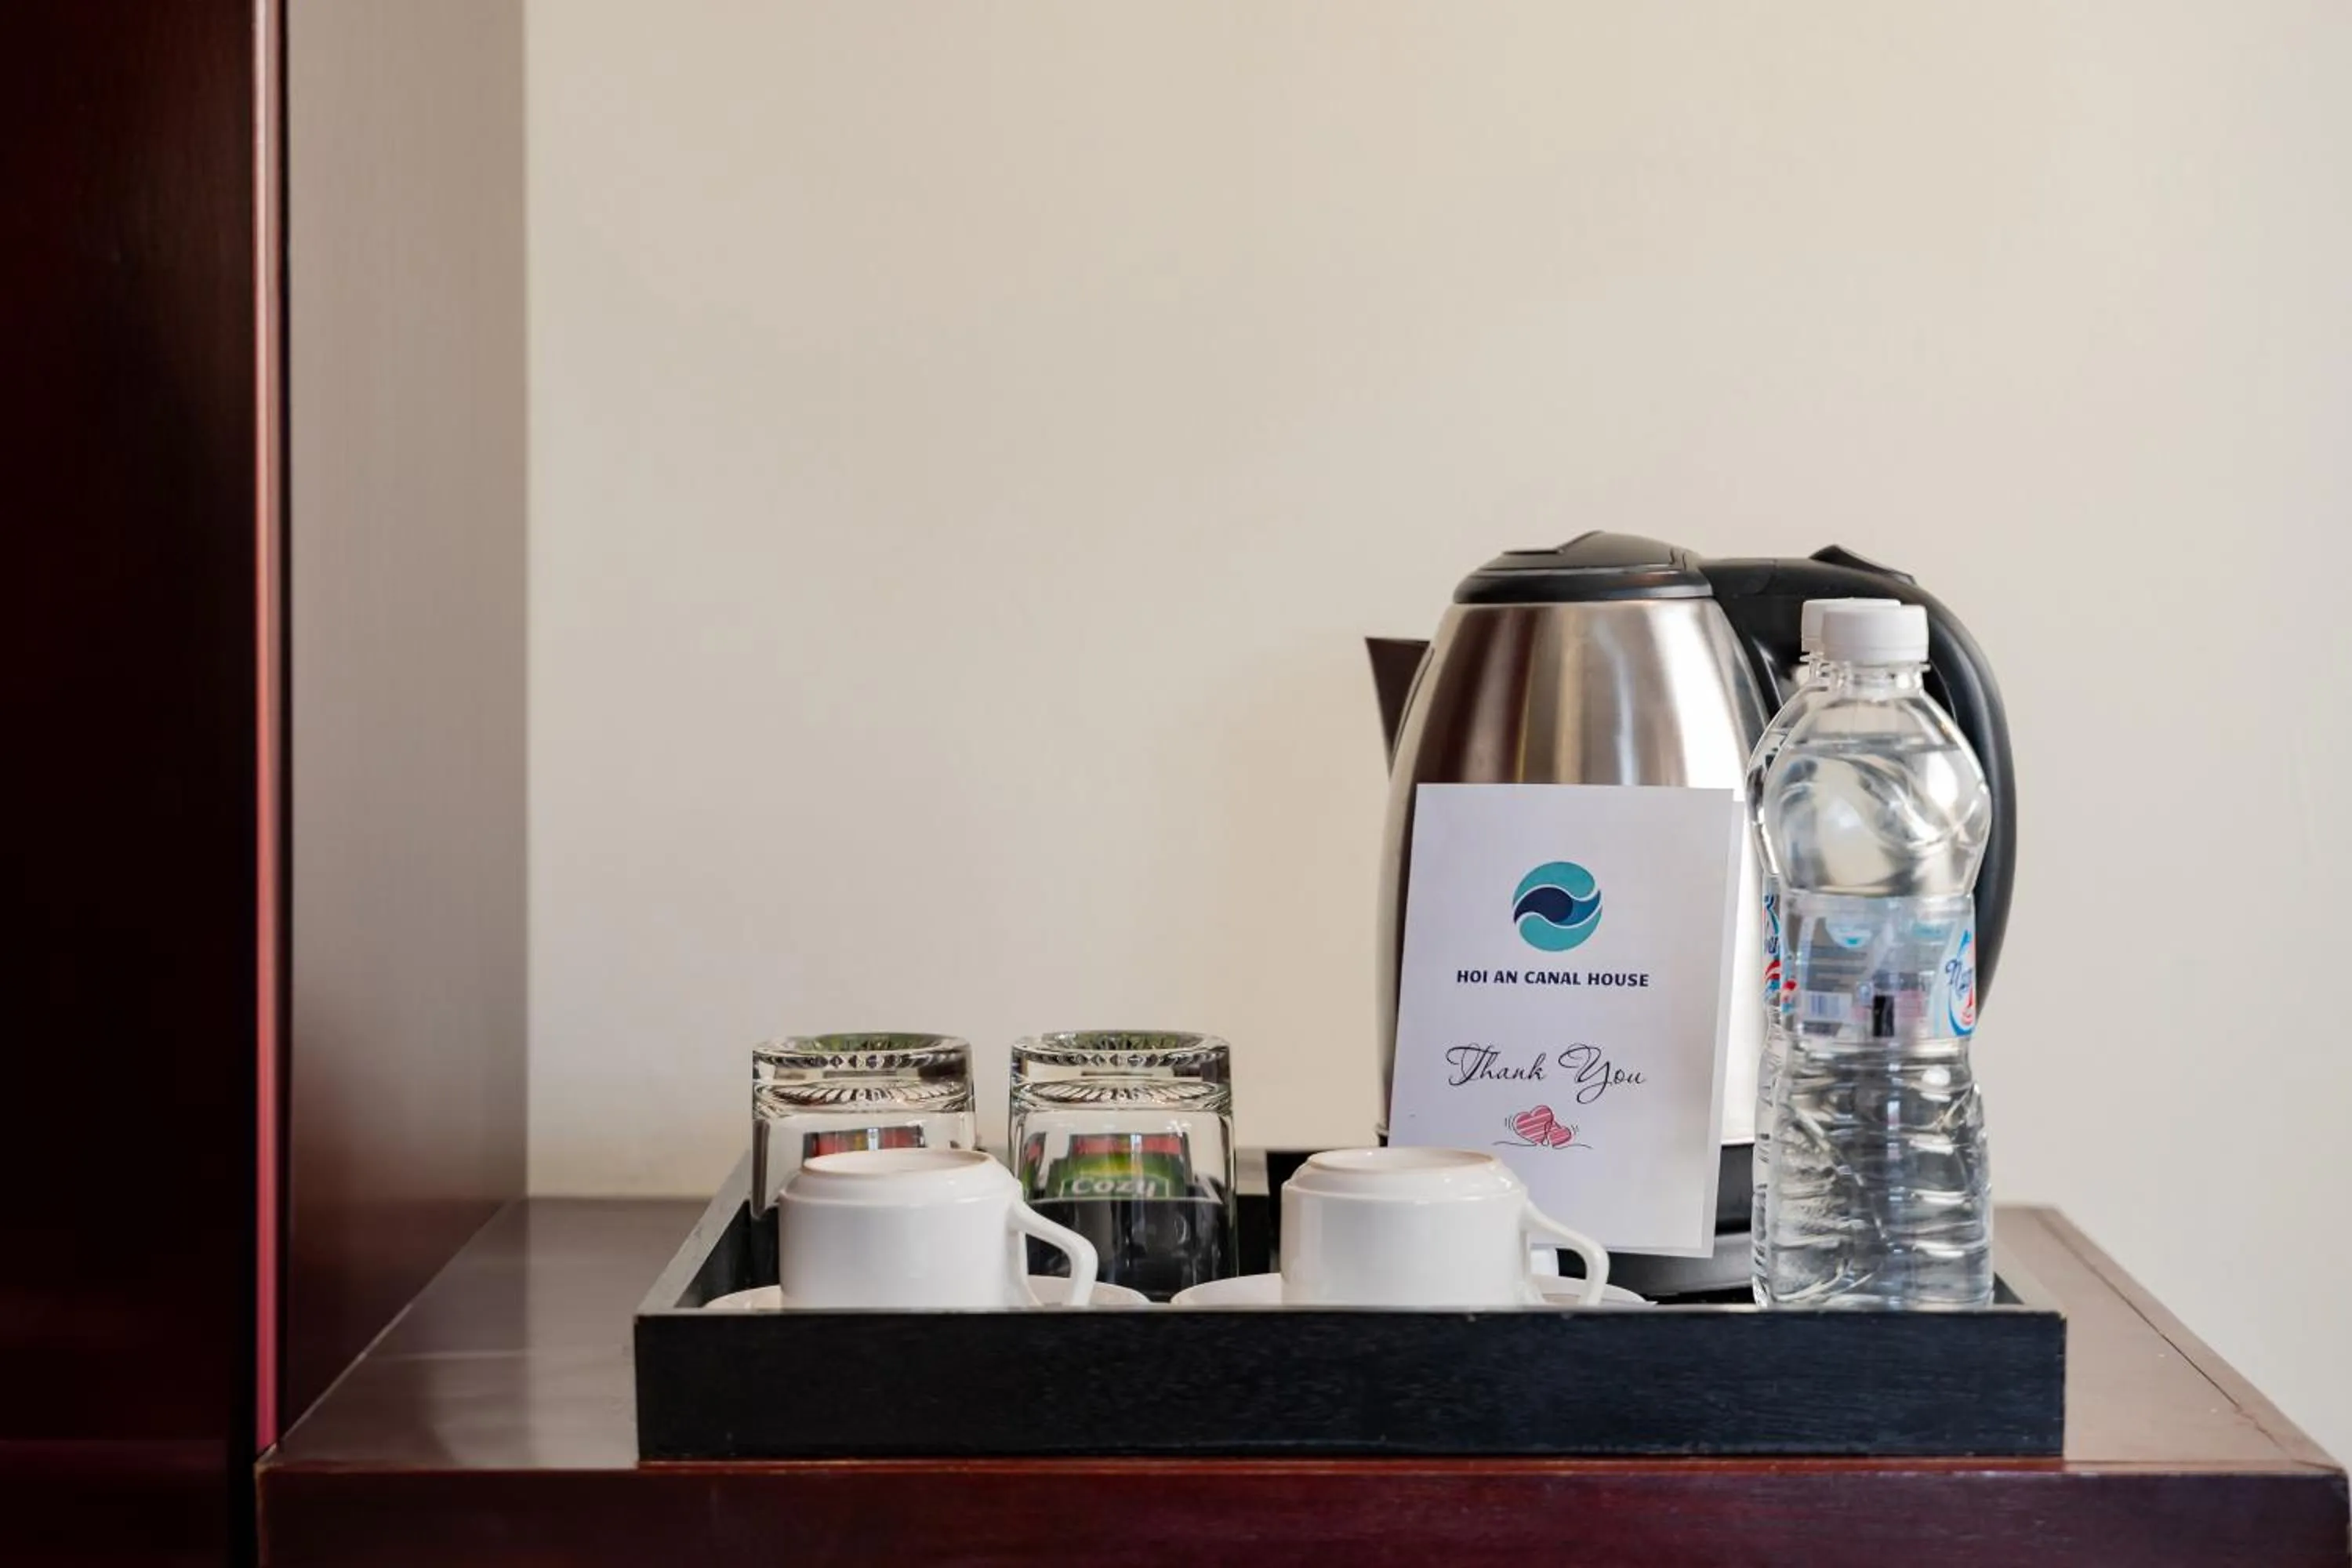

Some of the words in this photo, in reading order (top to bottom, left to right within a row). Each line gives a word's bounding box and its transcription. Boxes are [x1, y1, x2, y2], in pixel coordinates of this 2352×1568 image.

[1456, 970, 1488, 984] HOI
[1493, 971, 1518, 985] AN
[1523, 971, 1581, 986] CANAL
[1587, 972, 1650, 987] HOUSE
[1446, 1043, 1546, 1086] Thank
[1558, 1043, 1646, 1104] You
